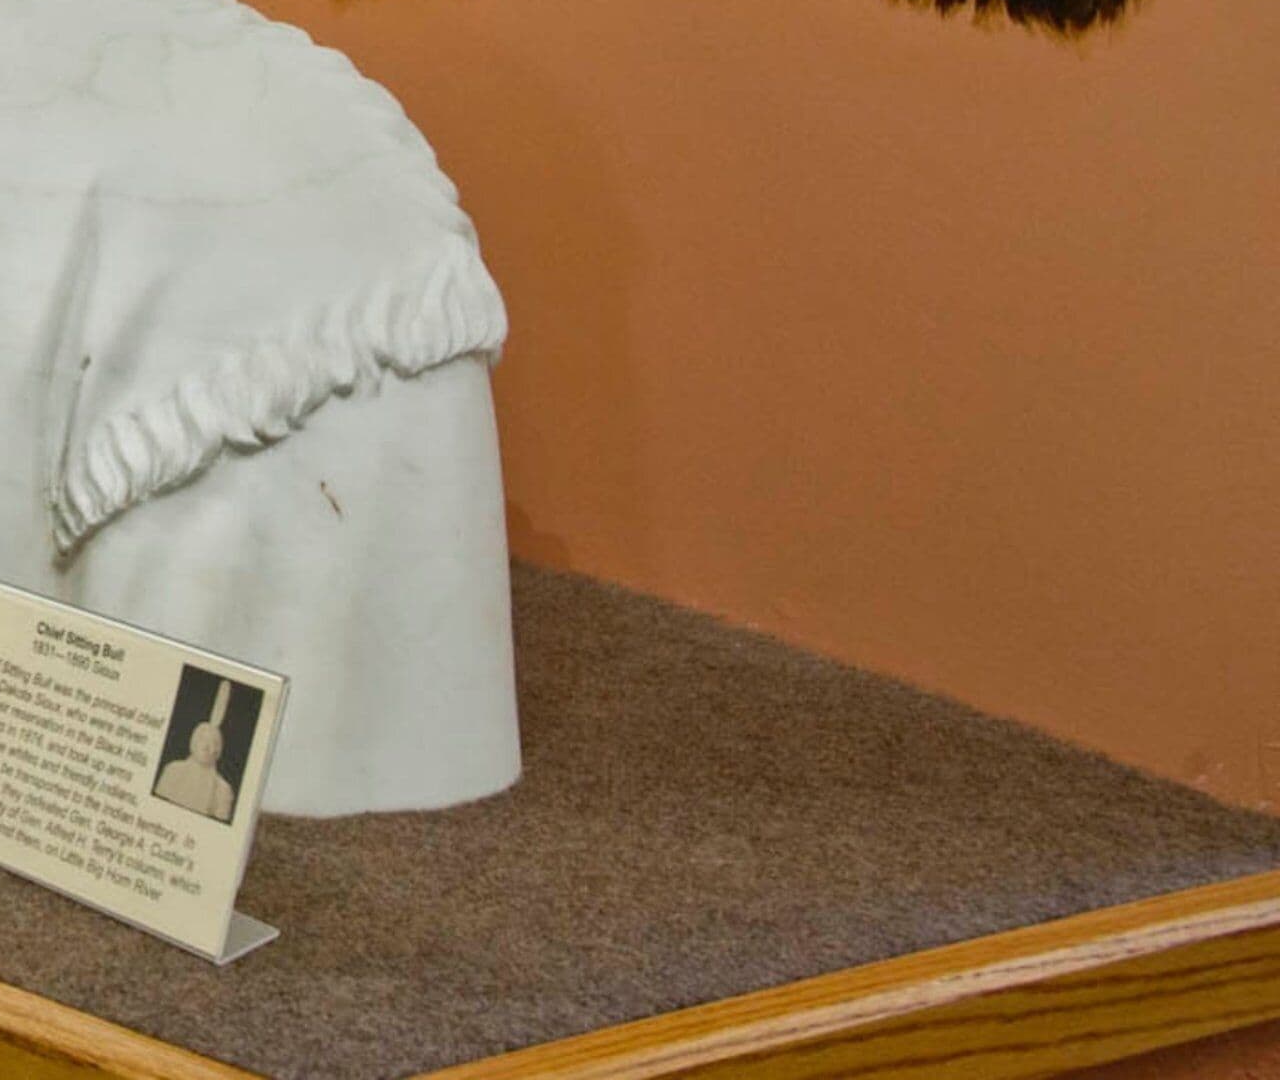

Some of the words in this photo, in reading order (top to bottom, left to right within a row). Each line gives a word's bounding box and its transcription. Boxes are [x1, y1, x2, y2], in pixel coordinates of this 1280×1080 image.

[36, 621, 64, 640] Chief
[66, 631, 100, 656] Sitting
[102, 643, 124, 661] Bull
[1, 660, 31, 684] Sitting
[32, 672, 52, 688] Bull
[53, 683, 72, 696] was
[75, 688, 91, 703] the
[91, 696, 136, 719] principal
[136, 712, 164, 729] chief
[92, 660, 119, 680] Sioux
[11, 707, 63, 733] reservation
[65, 727, 75, 738] in
[76, 730, 93, 745] the
[95, 735, 123, 755] Black
[126, 749, 147, 766] Hills
[66, 708, 87, 722] who
[89, 716, 113, 732] were
[115, 725, 147, 743] driven
[6, 725, 16, 736] in
[47, 741, 67, 756] and
[68, 747, 89, 763] took
[91, 759, 105, 772] up
[106, 764, 132, 781] arms
[40, 758, 60, 773] and
[62, 765, 97, 790] friendly
[0, 762, 13, 776] be
[71, 790, 83, 803] to
[84, 795, 100, 811] the
[1, 782, 22, 801] they
[25, 793, 68, 818] defeated
[96, 820, 134, 846] George
[6, 806, 20, 818] of
[44, 821, 75, 842] Alfred
[169, 875, 200, 894] which
[44, 843, 58, 856] on
[59, 851, 84, 867] Little
[86, 858, 103, 879] Big
[106, 867, 131, 885] Horn
